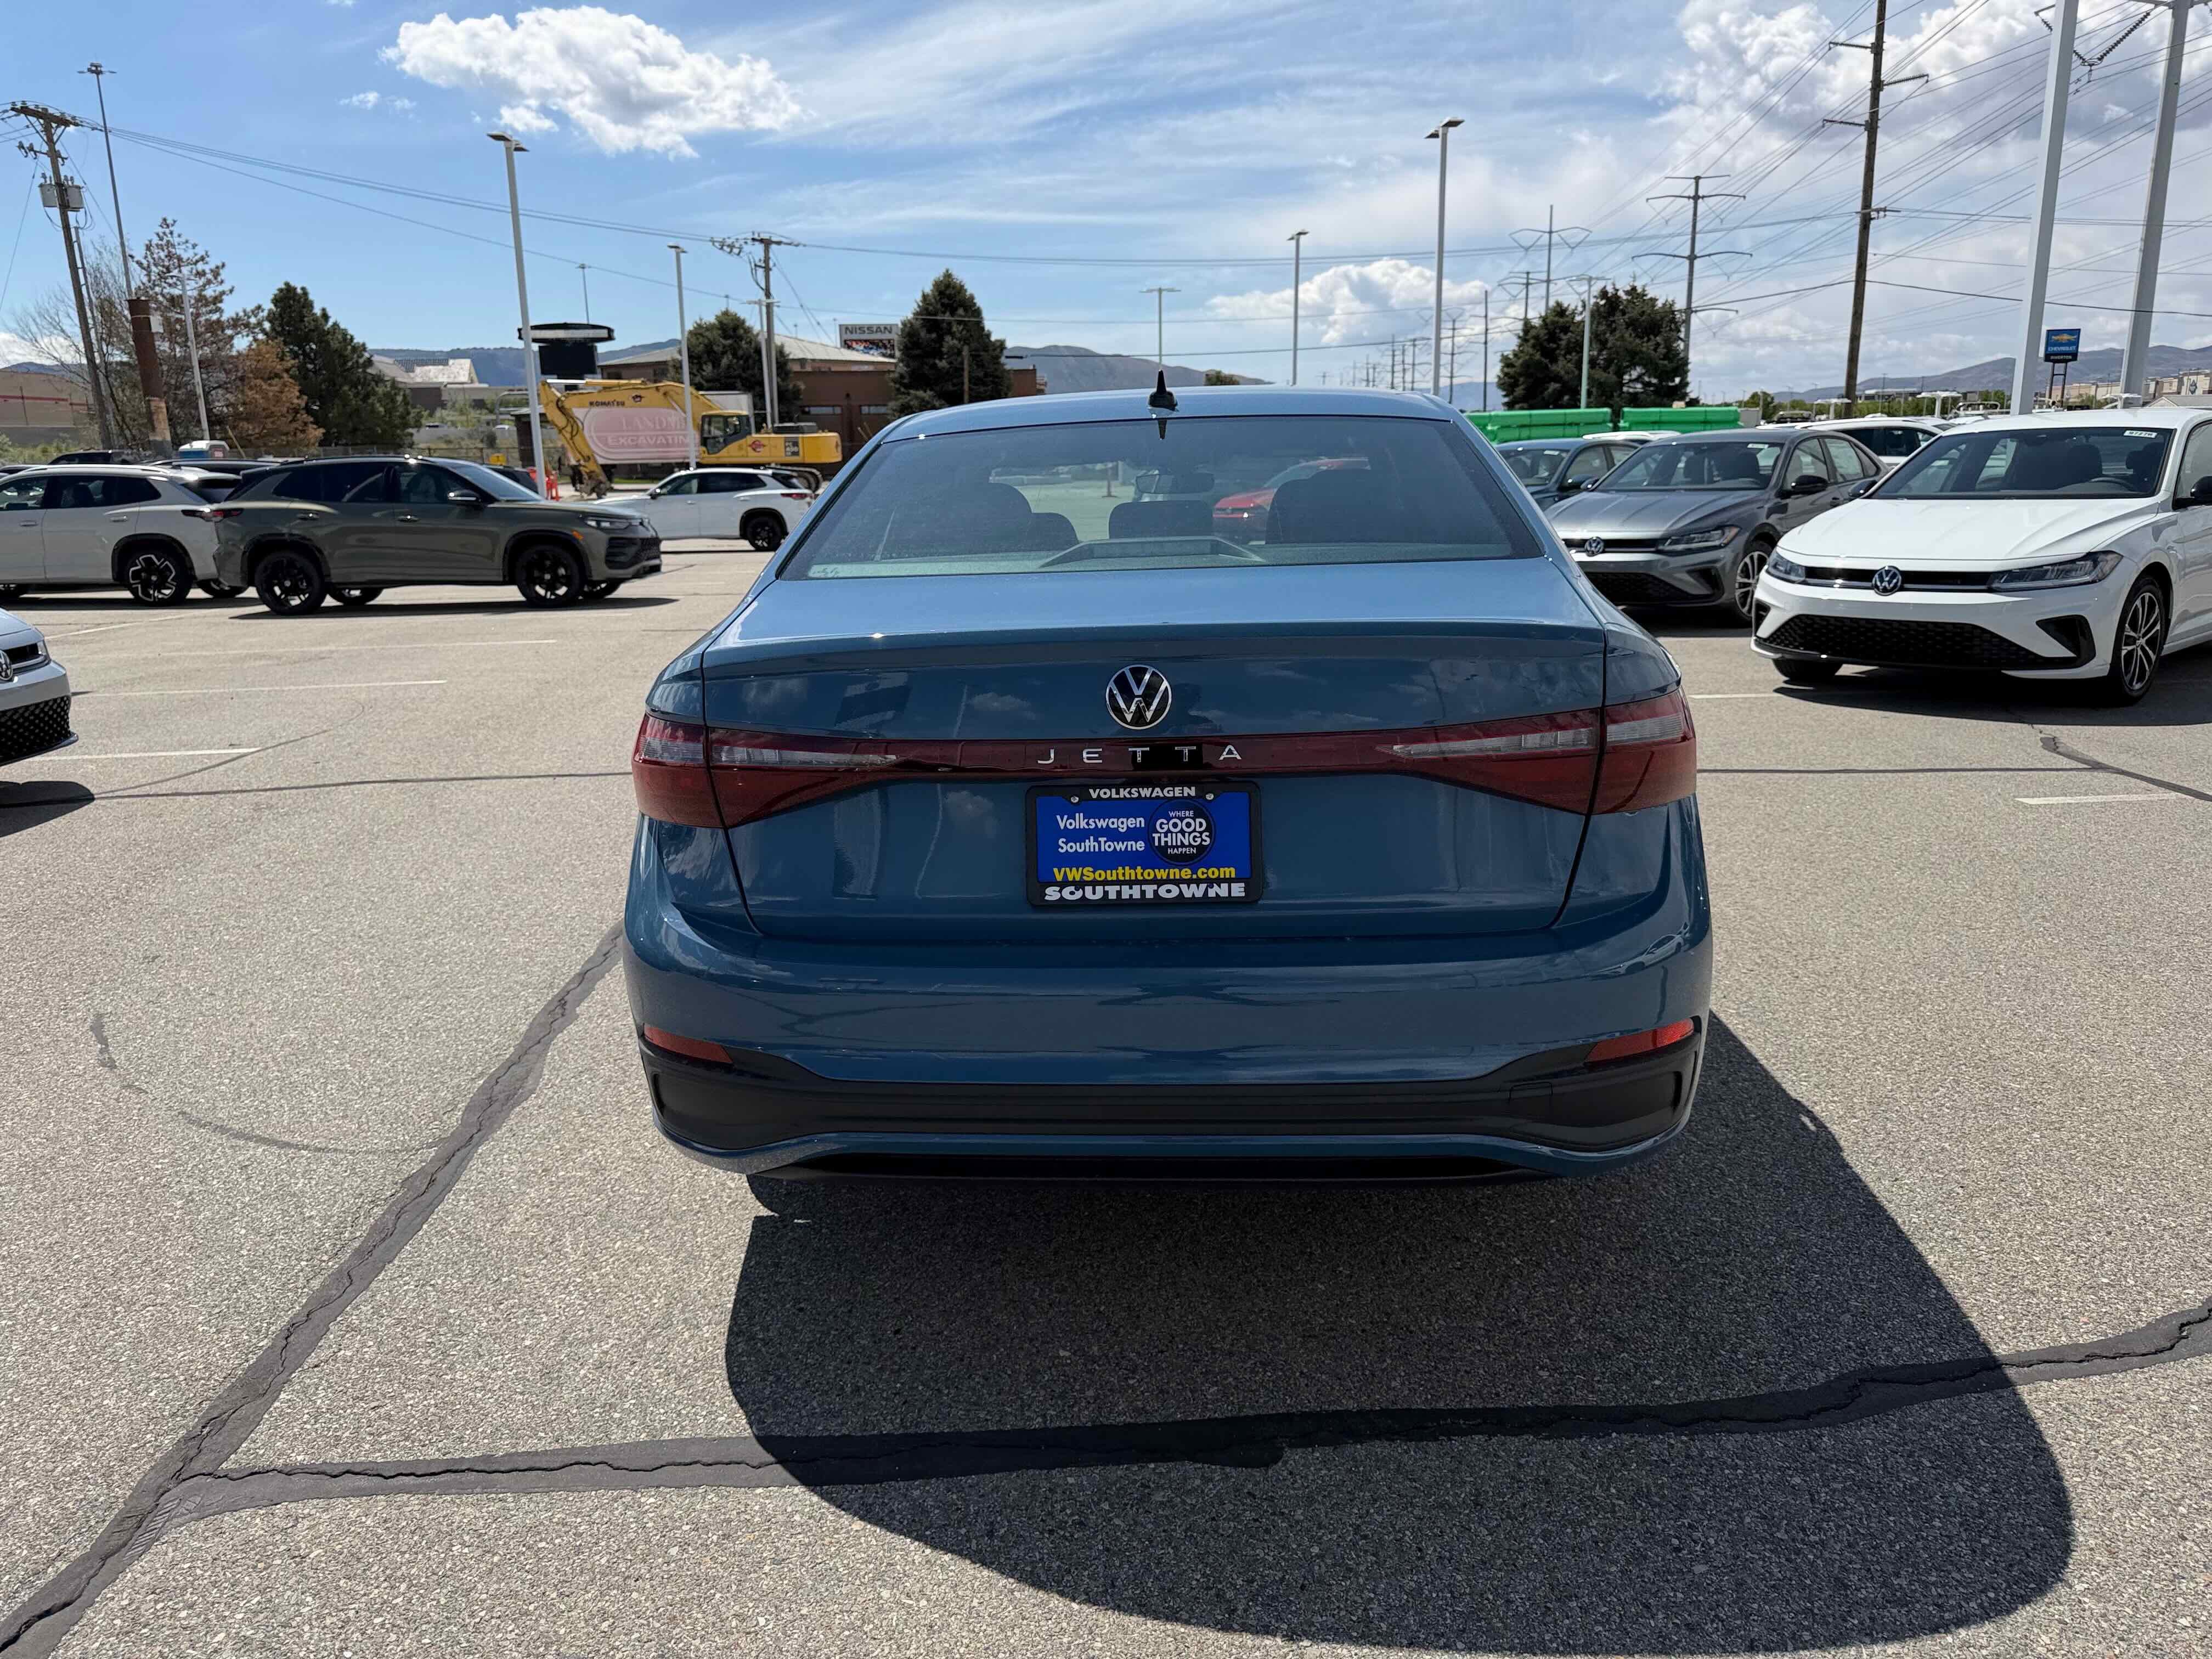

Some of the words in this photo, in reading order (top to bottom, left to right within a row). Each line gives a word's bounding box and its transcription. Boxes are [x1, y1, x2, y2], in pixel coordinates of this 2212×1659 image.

[845, 326, 893, 334] NISSAN
[607, 435, 691, 446] EXCAVATIN
[1037, 745, 1242, 764] JETTA
[1088, 787, 1196, 799] VOLKSWAGEN
[1056, 812, 1146, 832] Volkswagen
[1156, 818, 1207, 832] GOOD
[1058, 836, 1146, 853] SouthTowne
[1152, 832, 1211, 846] THINGS
[1053, 866, 1236, 882] VWSouthtowne.com
[1044, 882, 1246, 901] SOUTHTOWNE
